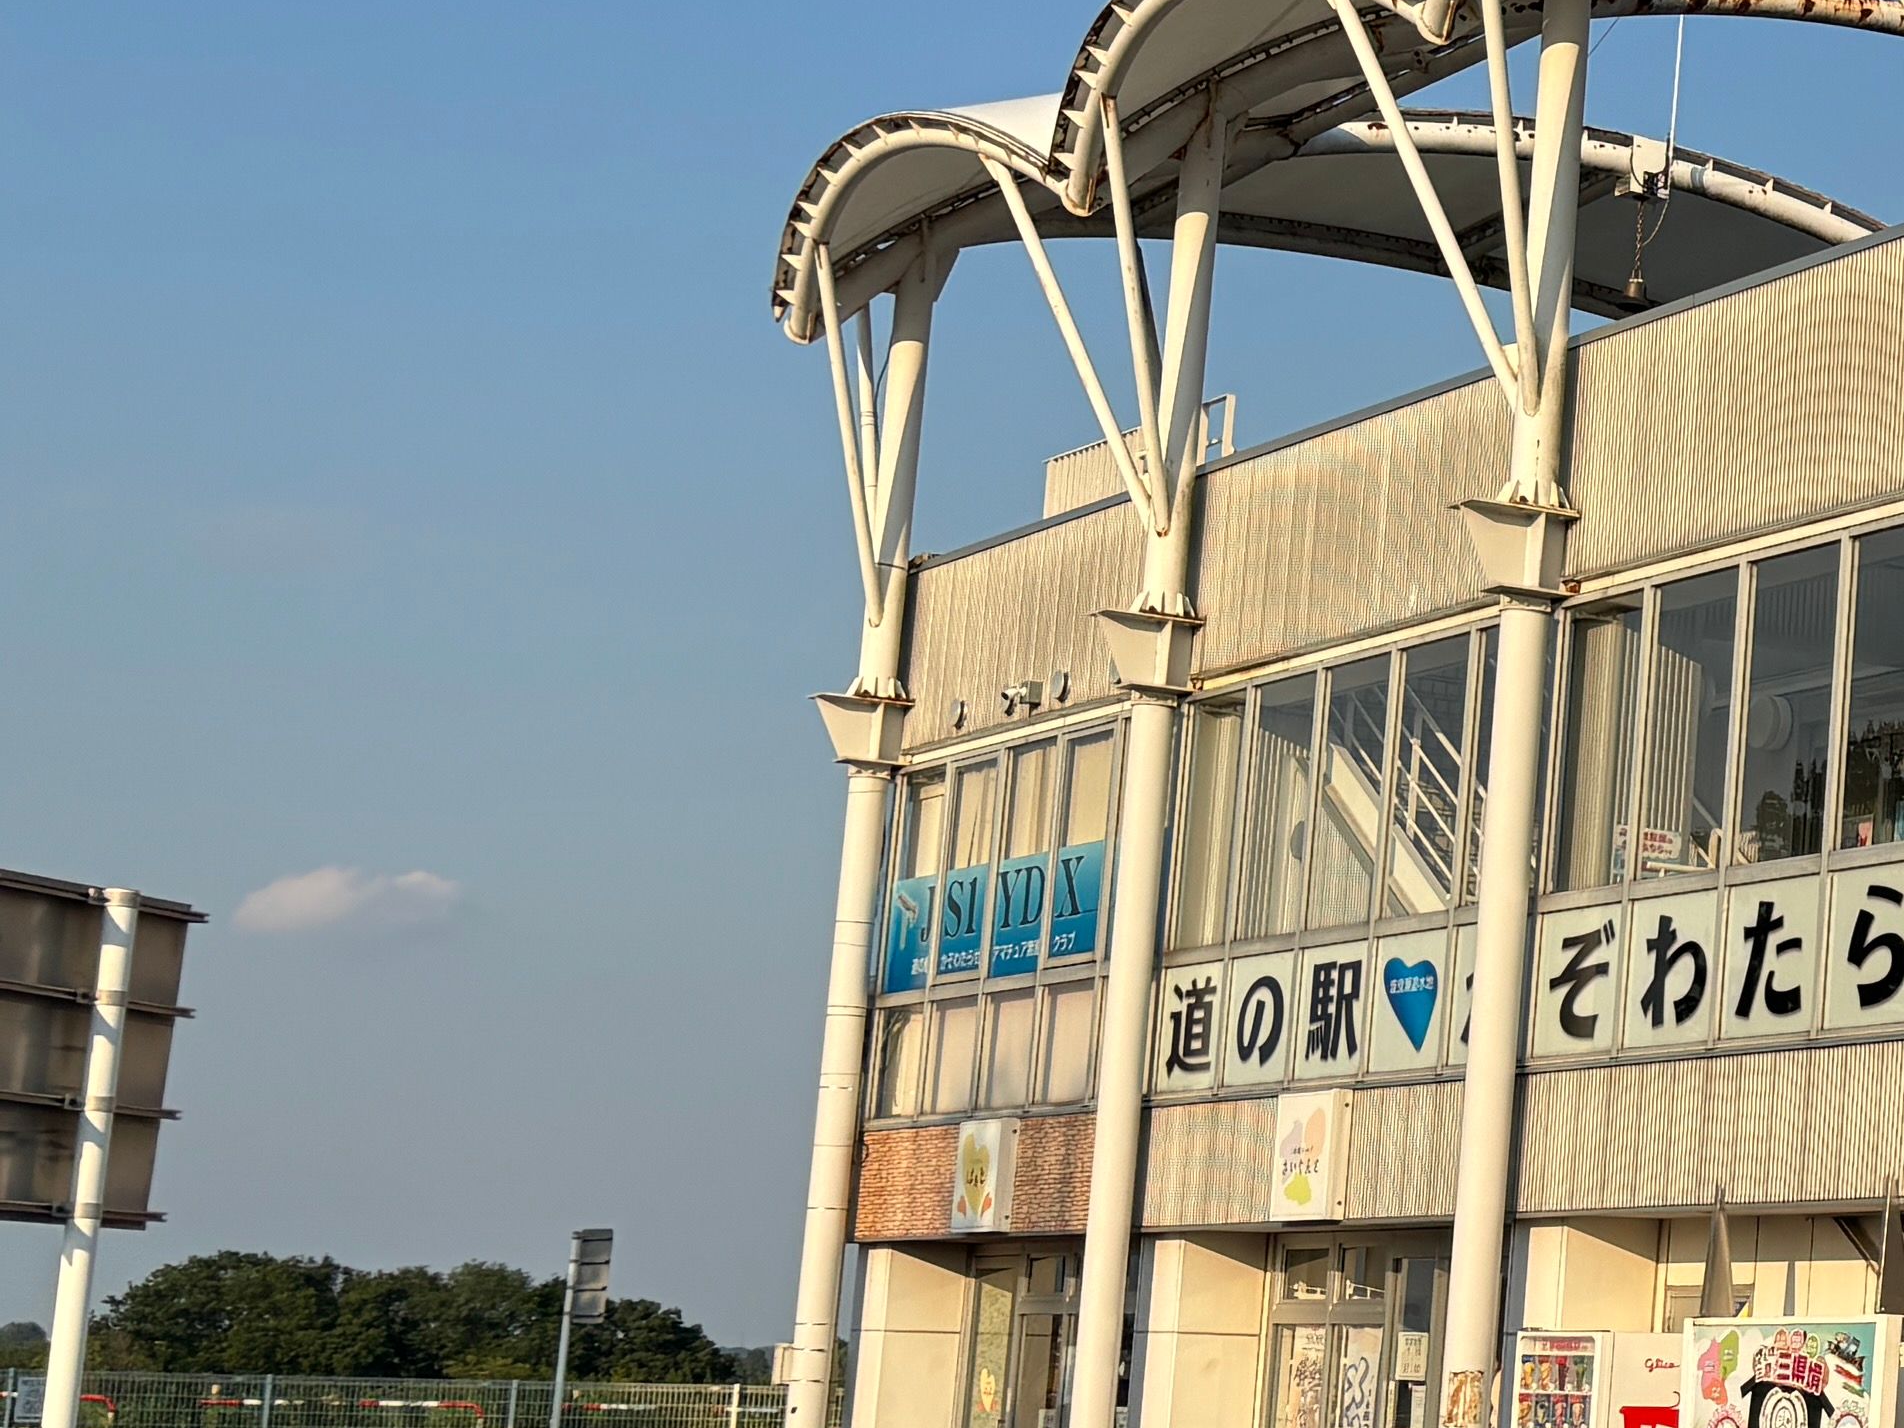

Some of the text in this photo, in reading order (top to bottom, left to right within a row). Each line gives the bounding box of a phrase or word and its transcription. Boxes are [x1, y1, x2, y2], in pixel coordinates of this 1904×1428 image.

[1165, 959, 1363, 1079] 道の駅
[1644, 1358, 1681, 1373] Glico
[1776, 1352, 1825, 1396] 三県境
